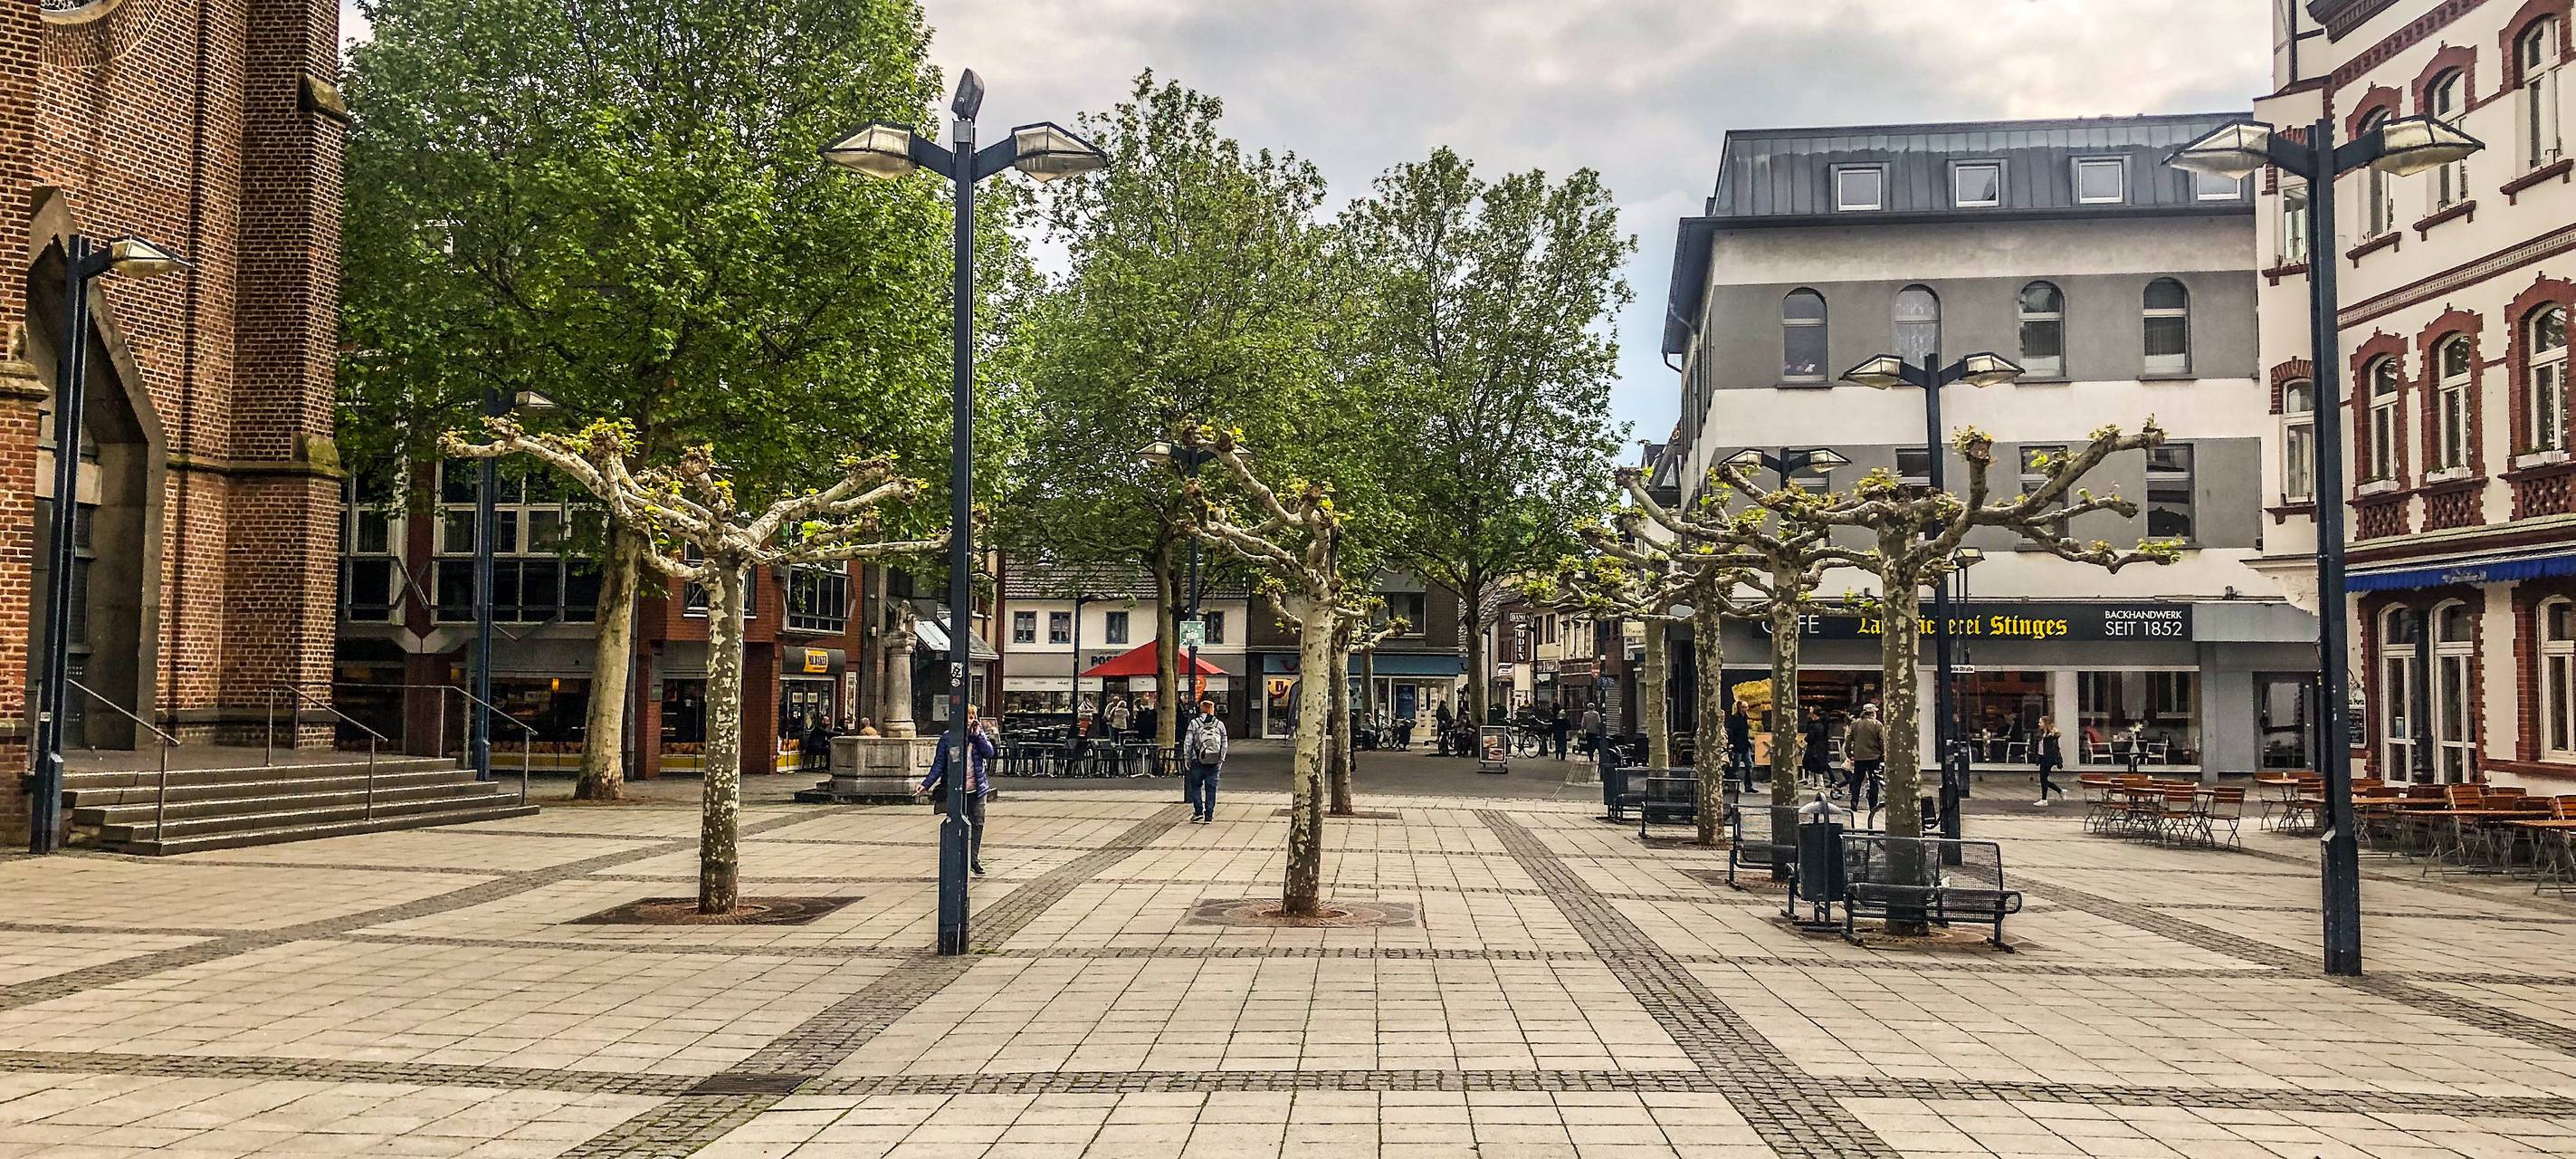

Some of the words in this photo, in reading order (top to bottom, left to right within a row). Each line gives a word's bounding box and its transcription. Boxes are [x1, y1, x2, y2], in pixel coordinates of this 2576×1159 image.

[2104, 610, 2182, 619] BACKHANDWERK
[1989, 614, 2067, 639] Stinges
[2104, 621, 2137, 636] SEIT
[2143, 621, 2182, 636] 1852
